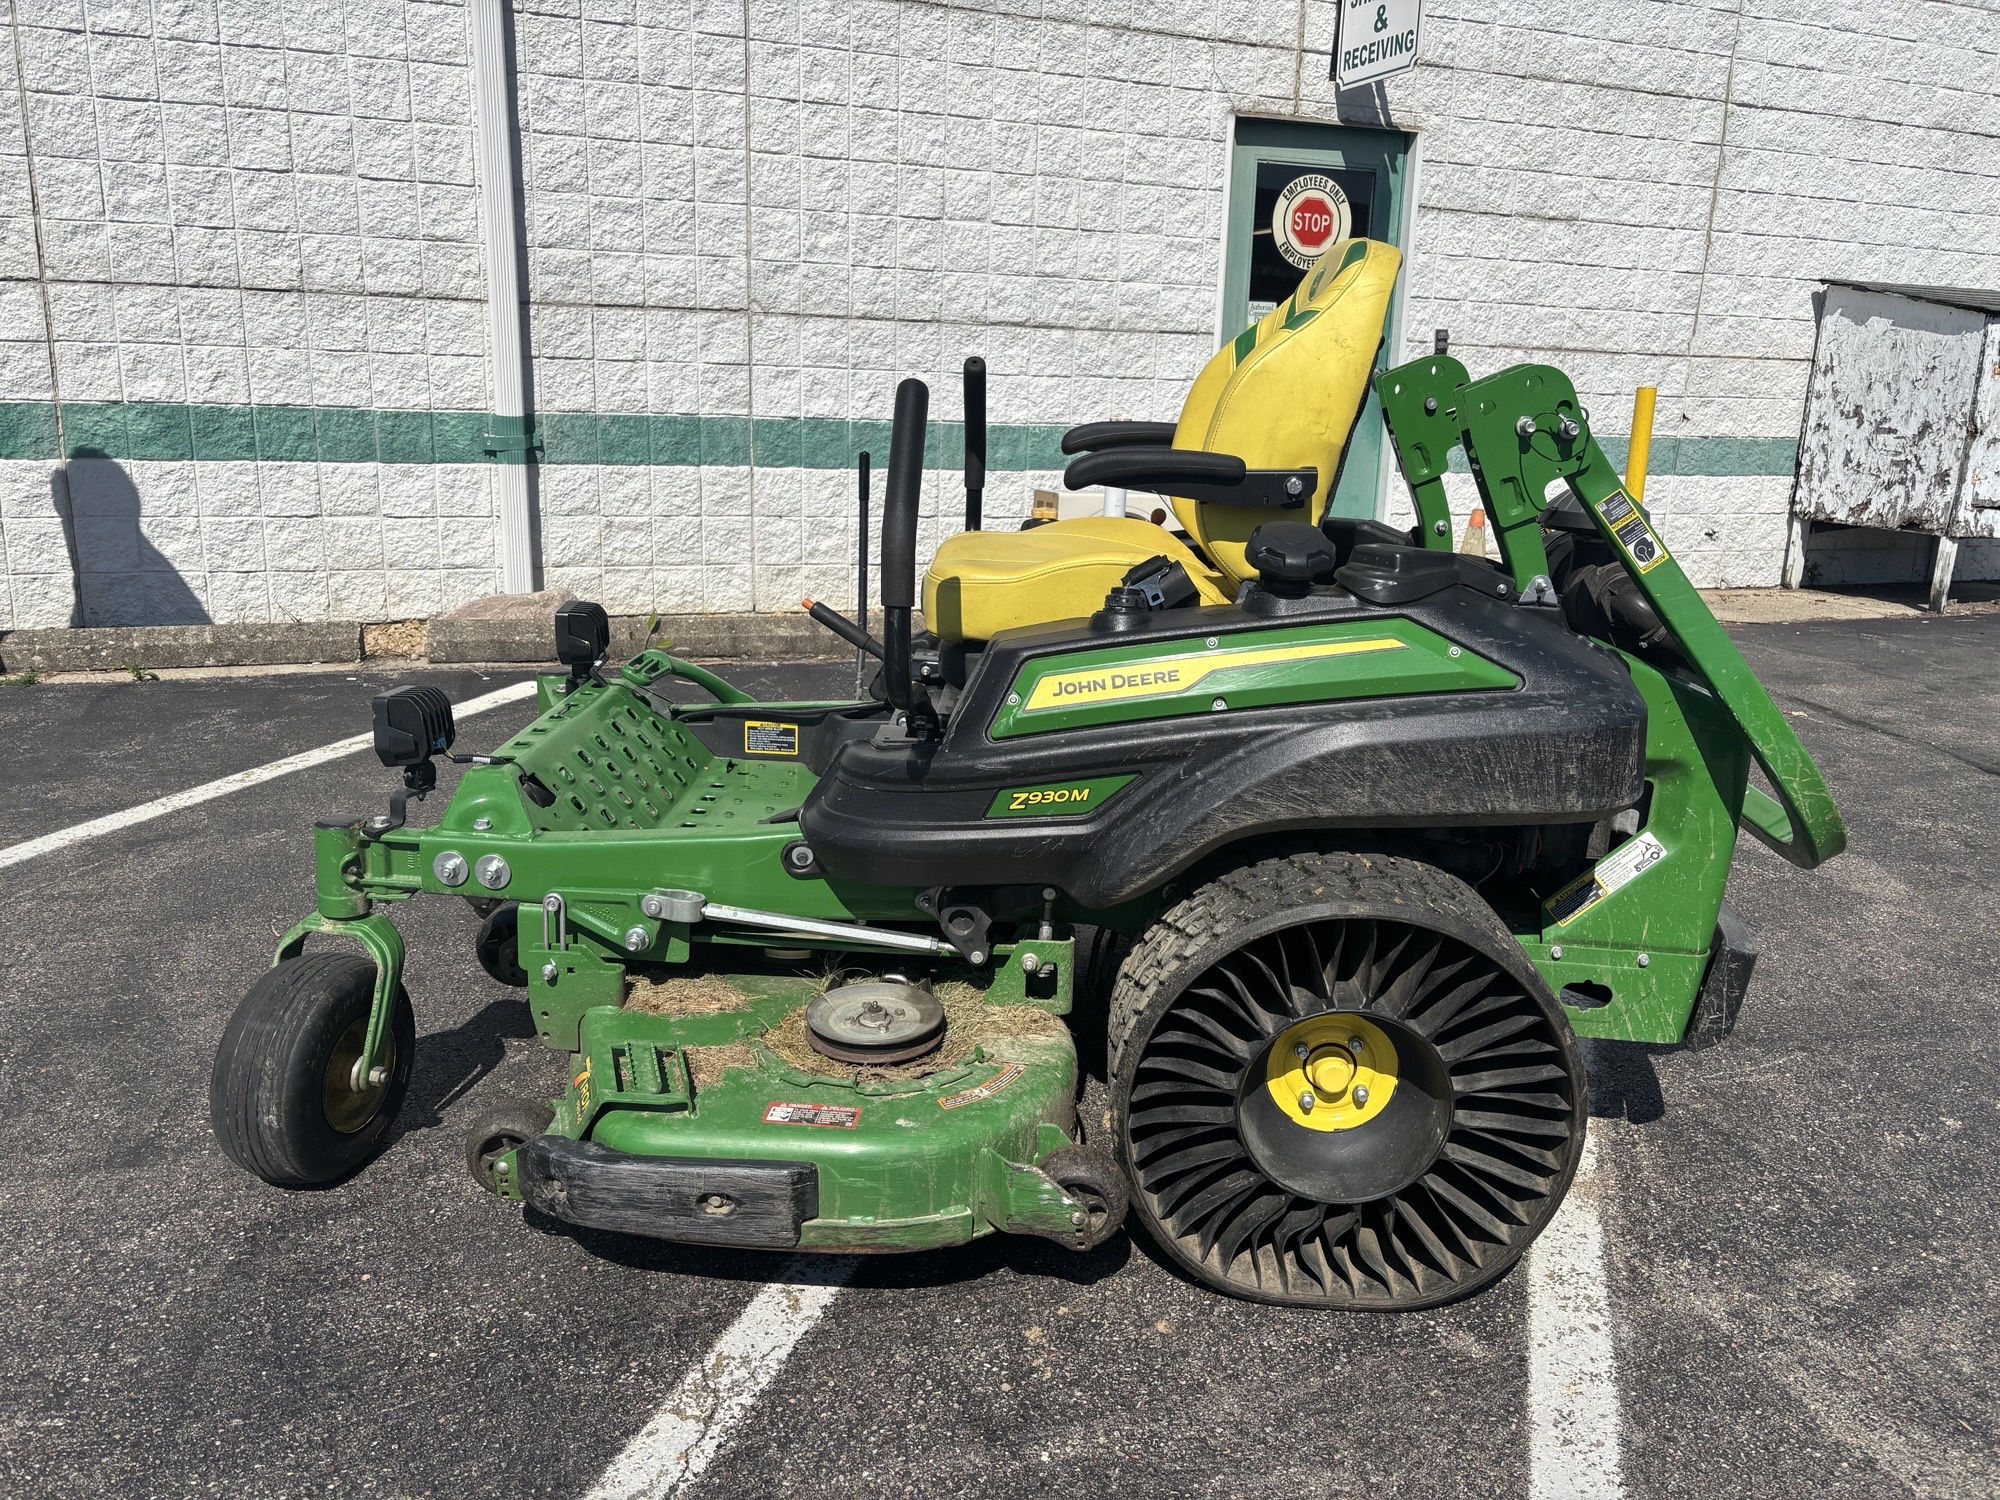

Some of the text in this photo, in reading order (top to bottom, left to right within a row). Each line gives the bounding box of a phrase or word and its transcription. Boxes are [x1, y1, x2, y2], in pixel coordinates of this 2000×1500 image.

[1373, 4, 1388, 33] &
[1343, 29, 1415, 72] RECEIVING
[1282, 176, 1347, 206] EMPLOYEES ONLY
[1293, 212, 1331, 233] STOP
[1279, 241, 1319, 269] EMPLOYEE
[1053, 670, 1180, 697] JOHN DEERE
[1009, 788, 1090, 810] Z930M
